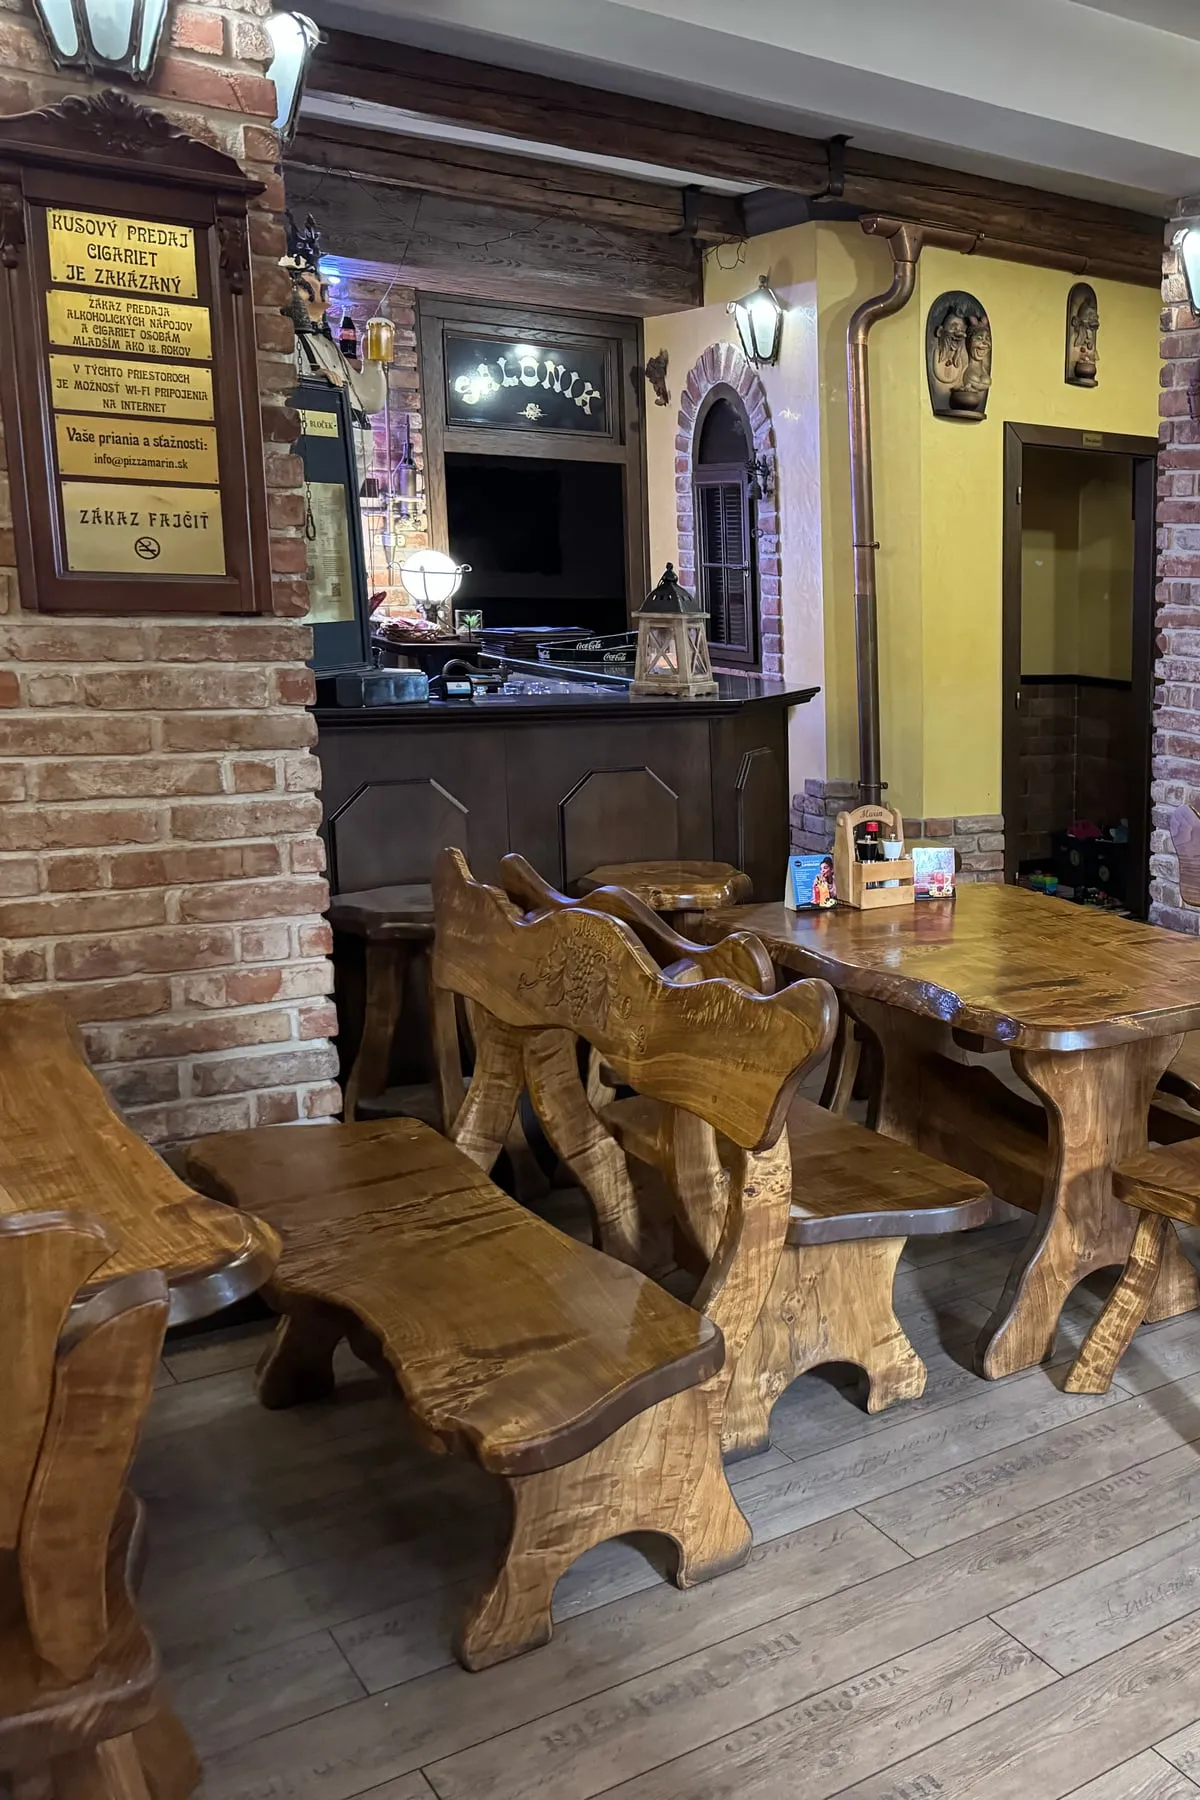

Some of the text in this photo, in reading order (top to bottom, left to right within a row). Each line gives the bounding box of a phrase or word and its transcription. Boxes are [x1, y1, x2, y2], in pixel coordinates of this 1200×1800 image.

[53, 214, 188, 248] KUSOVÝ PREDAJ
[88, 244, 158, 267] CIGARIET
[66, 265, 181, 293] JE ZAKÁZANÝ
[67, 309, 192, 332] ALKOHOLICKÝCH NÁPOJOV
[126, 303, 170, 317] PREDAJA
[82, 324, 180, 343] A CIGARIET OSOBÁM
[73, 336, 120, 349] MLADŠÍM
[126, 342, 144, 352] AKO
[161, 345, 190, 356] ROKOV
[73, 364, 189, 383] V TÝCHTO PRIESTOROCH
[56, 379, 68, 389] JE
[125, 385, 150, 396] WI-FI
[155, 387, 208, 400] PRIPOJENIA
[103, 399, 166, 413] NA INTERNET
[66, 427, 208, 450] Vaše priania a sťažnosti:
[94, 453, 188, 469] info@pizzamarin.sk
[80, 507, 208, 529] ZÁKAZ FAJČIŤ
